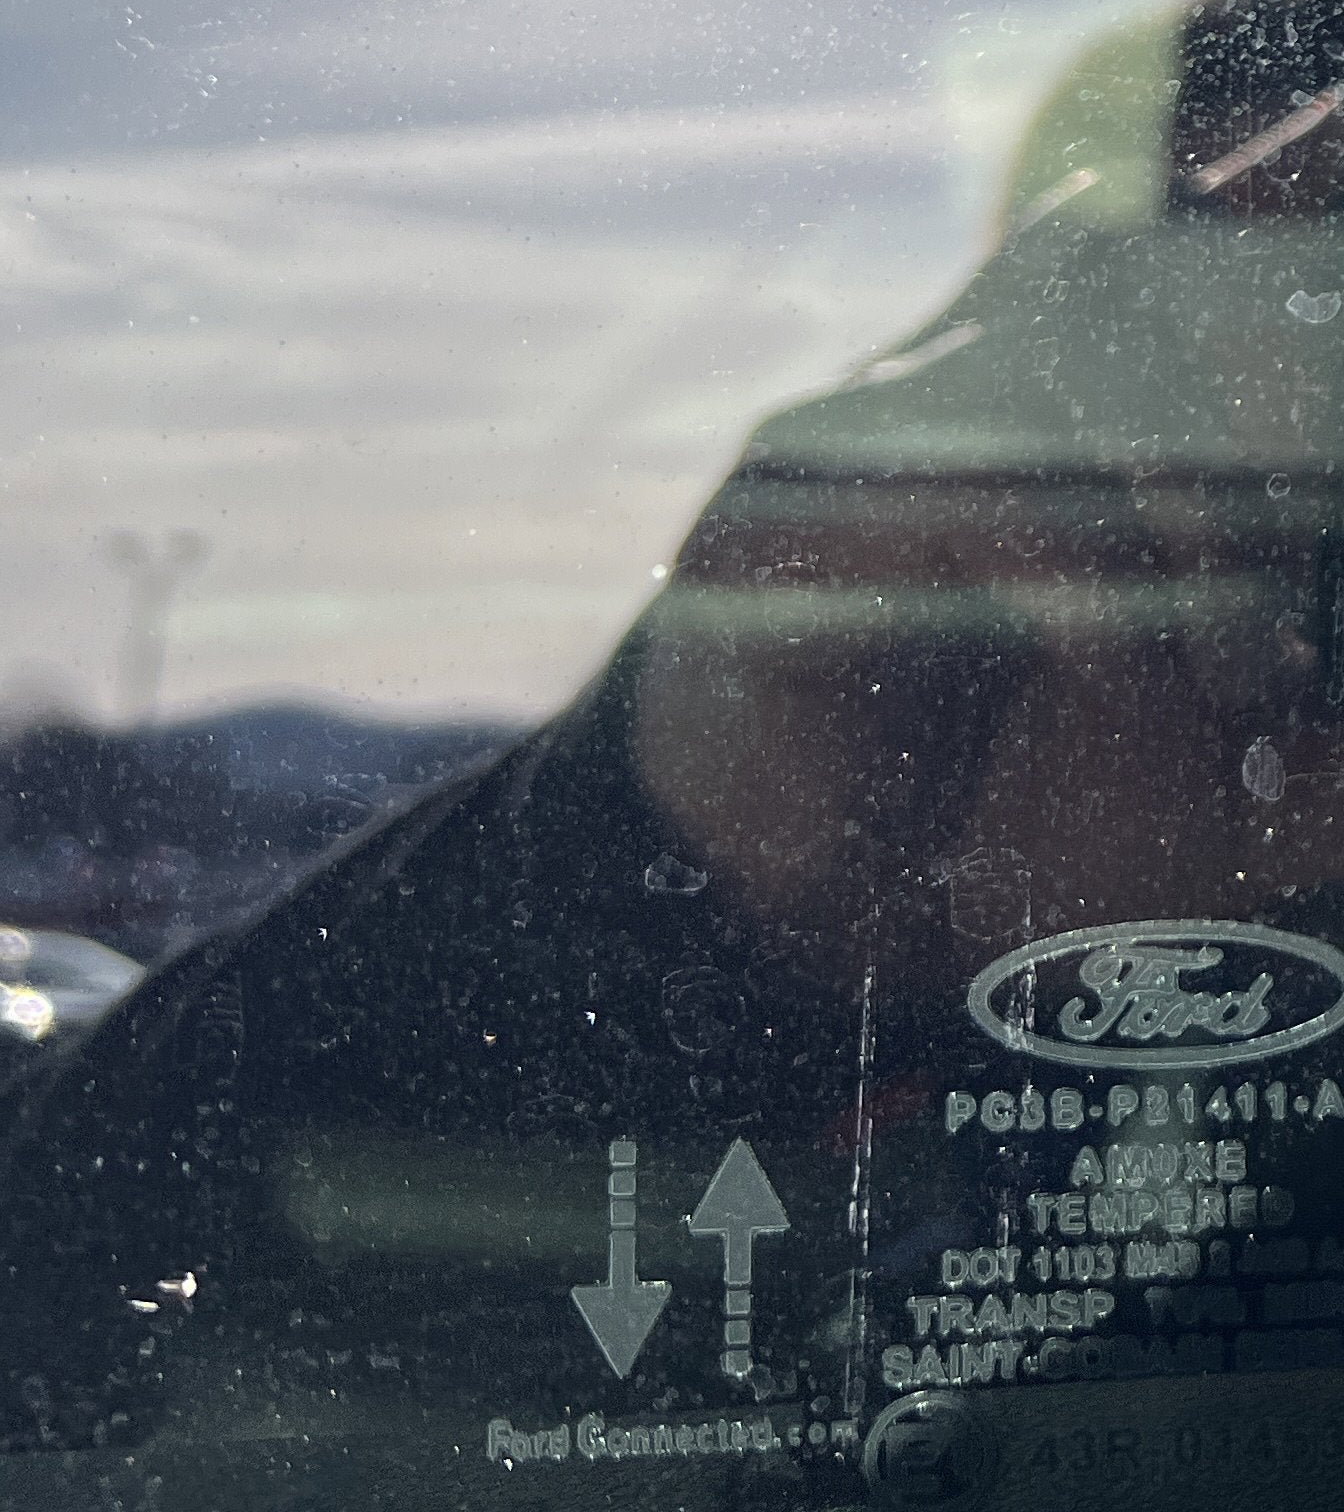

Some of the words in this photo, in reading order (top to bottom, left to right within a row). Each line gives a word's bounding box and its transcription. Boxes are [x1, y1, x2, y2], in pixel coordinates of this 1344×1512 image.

[1058, 945, 1275, 1041] Ford
[1025, 1184, 1295, 1236] TEMPERED
[939, 1245, 1020, 1289] DOT
[1031, 1242, 1117, 1282] 1103
[905, 1289, 1116, 1338] TRANSP
